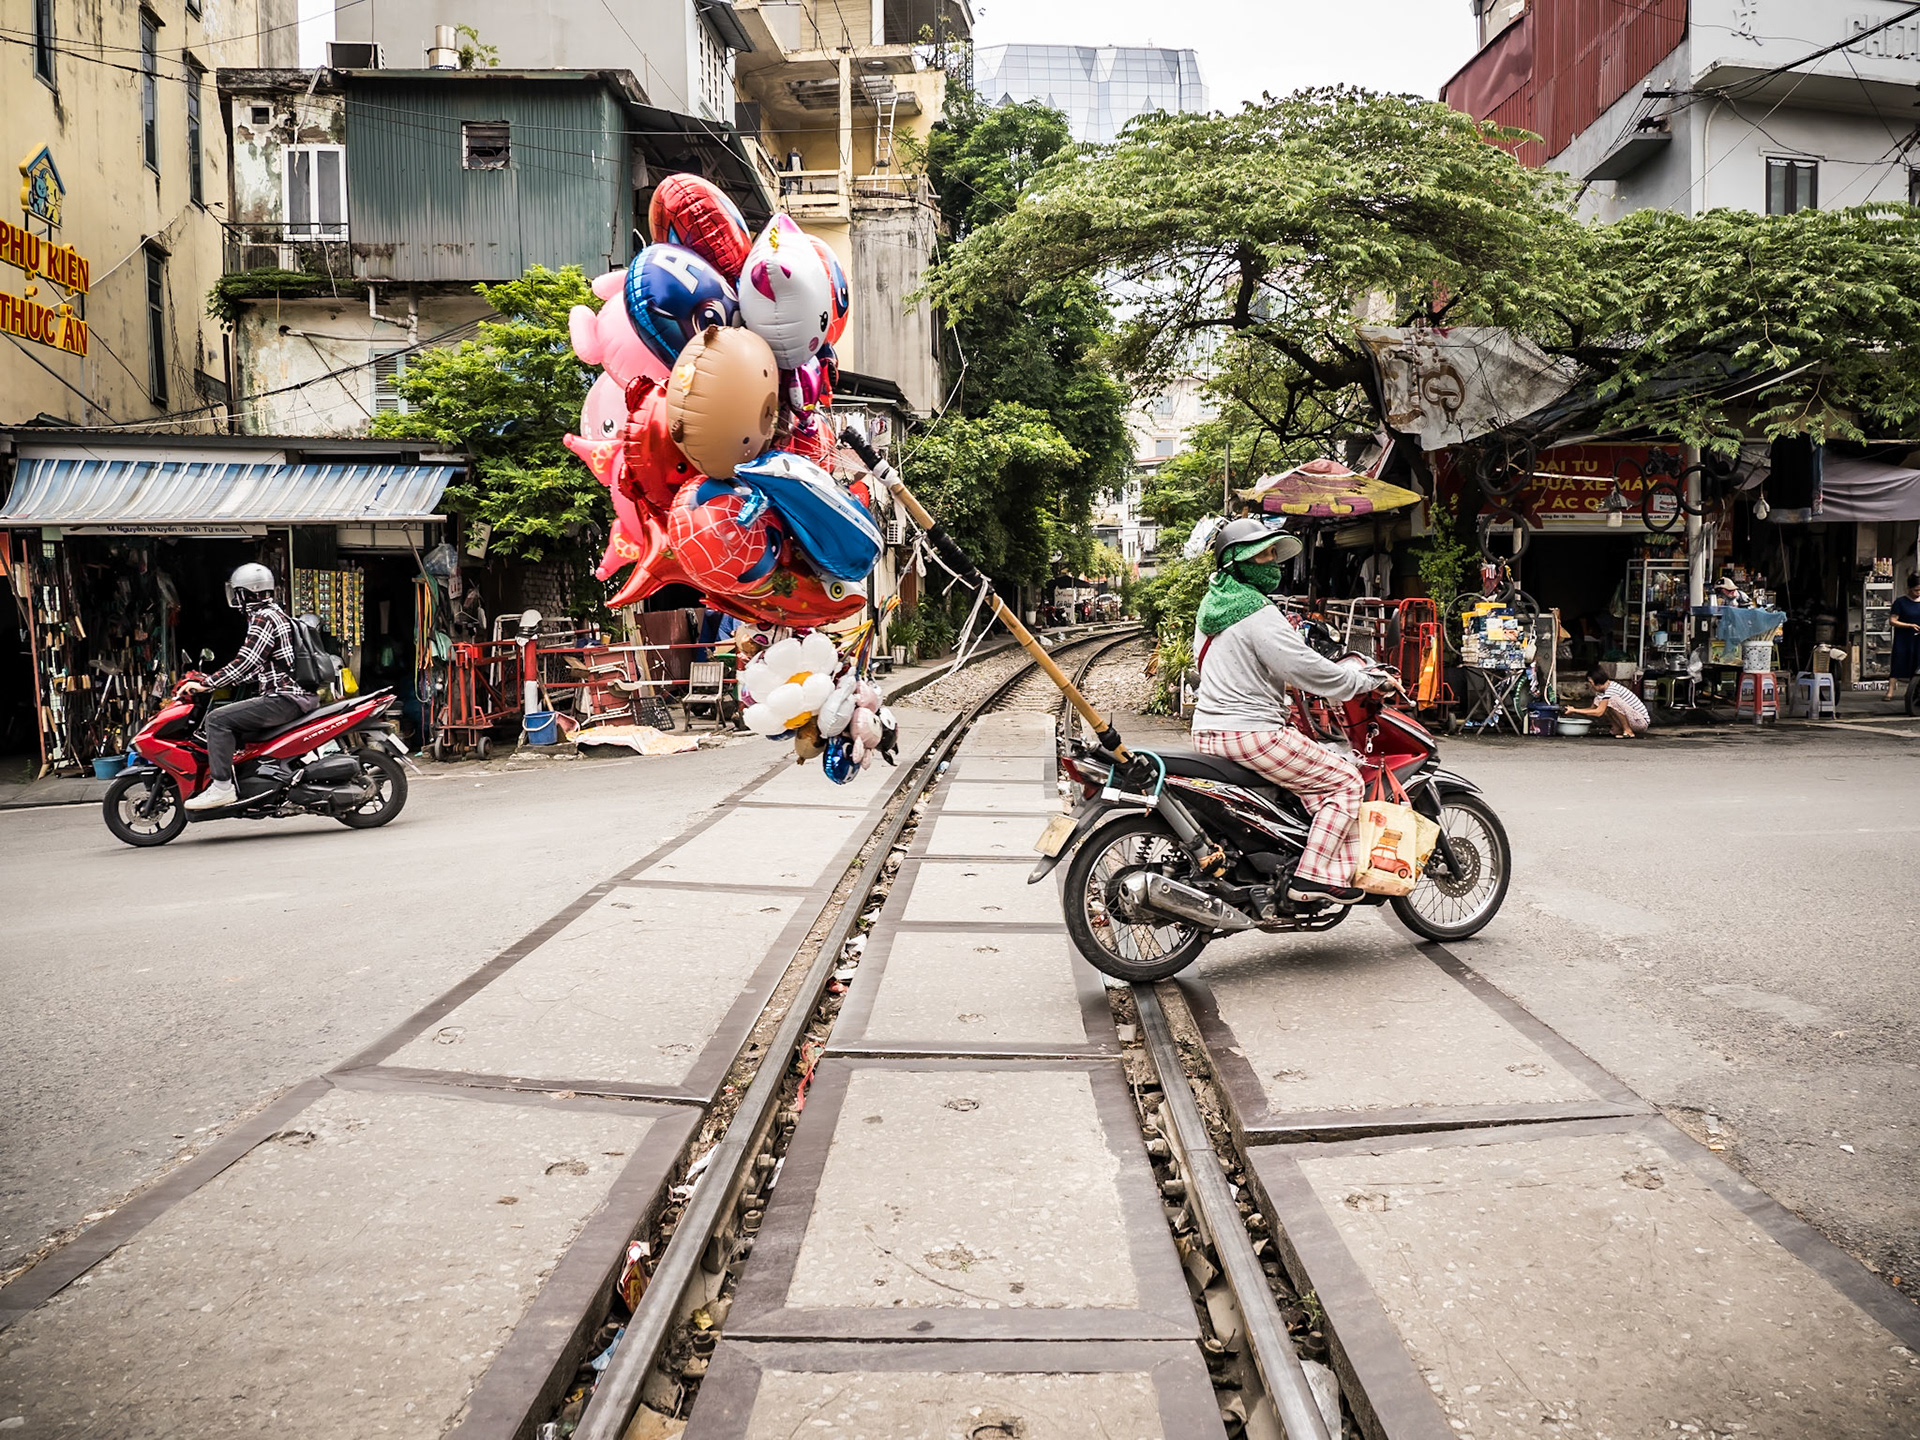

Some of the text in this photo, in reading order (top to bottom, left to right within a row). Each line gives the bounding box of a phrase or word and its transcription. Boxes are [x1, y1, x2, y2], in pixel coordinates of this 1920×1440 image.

[47, 241, 89, 296] KIỆN
[651, 248, 706, 295] A
[0, 286, 88, 356] THỨC ĂN
[1571, 460, 1599, 472] TU
[1615, 475, 1658, 491] MÁY
[1551, 493, 1578, 509] ÁC
